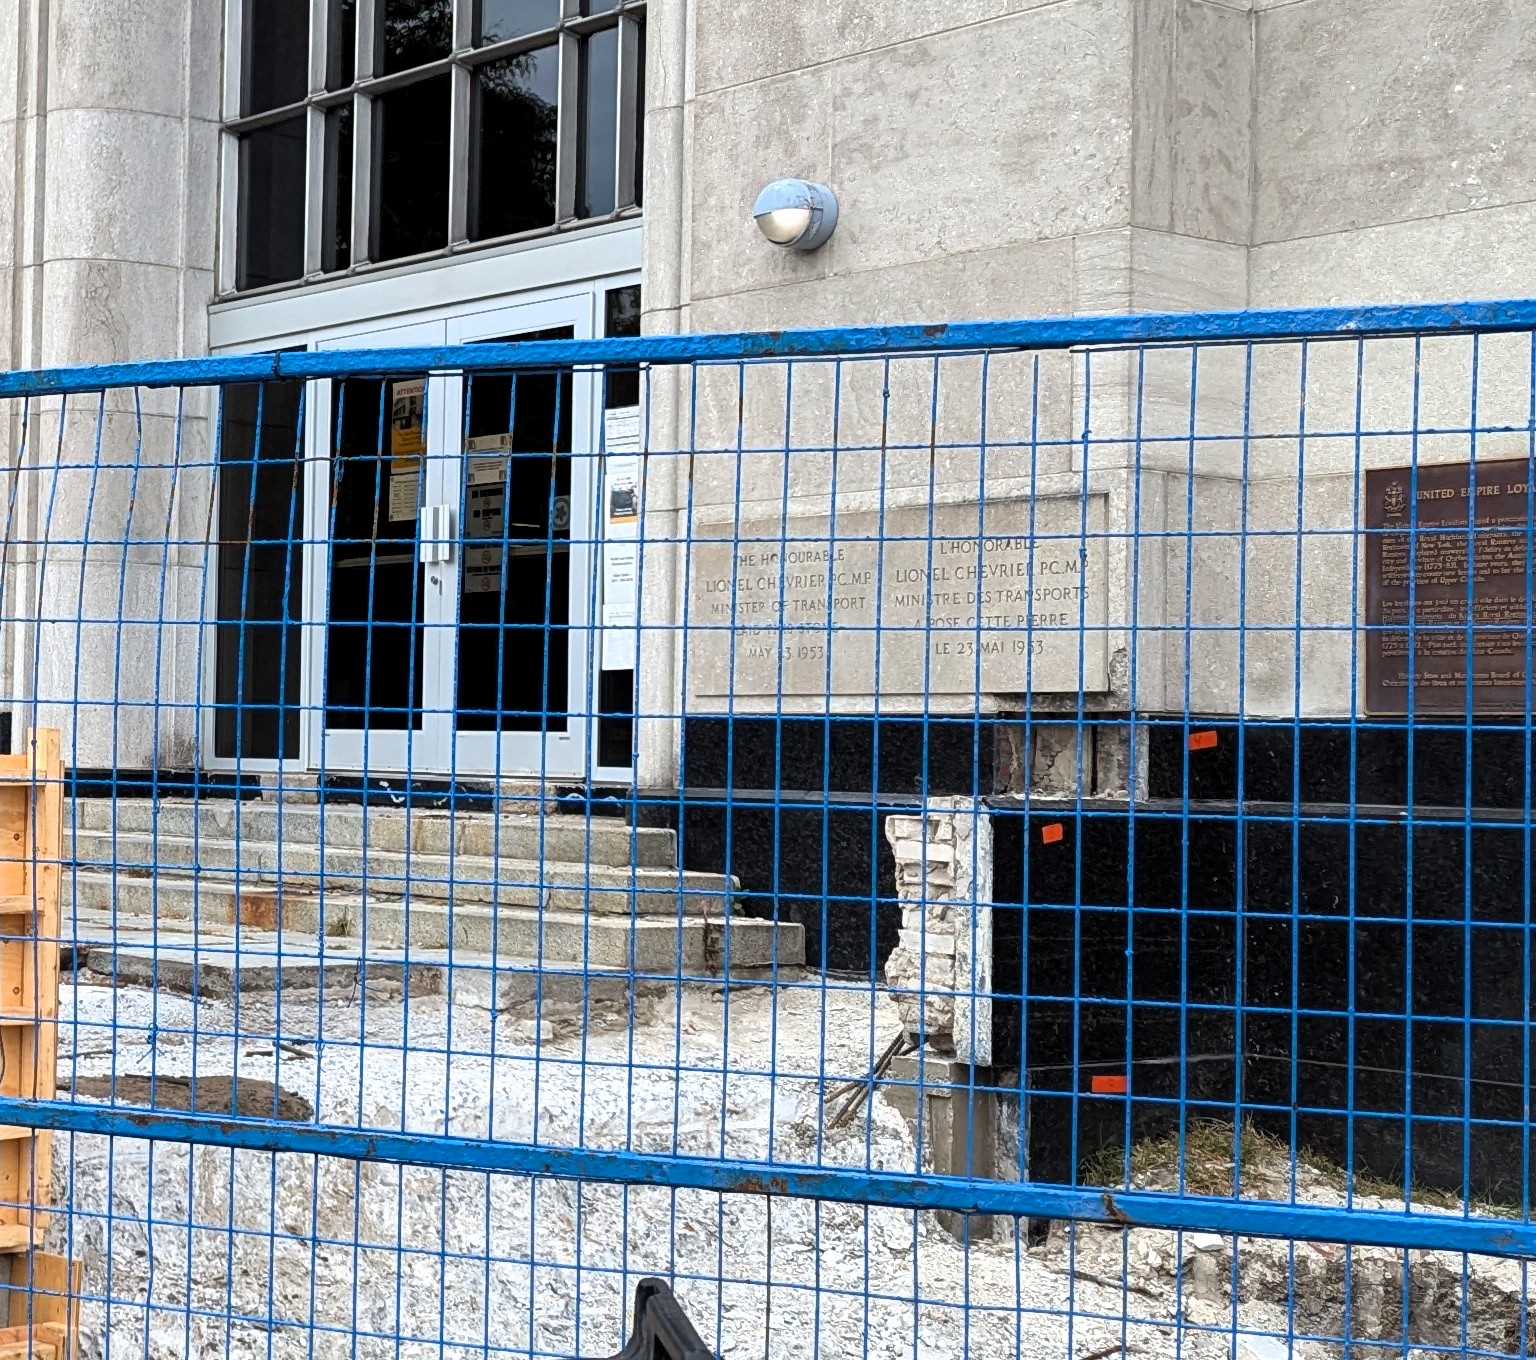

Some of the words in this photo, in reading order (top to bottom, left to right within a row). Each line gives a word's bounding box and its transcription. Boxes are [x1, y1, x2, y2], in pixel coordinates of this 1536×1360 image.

[1417, 488, 1454, 500] UNITED
[734, 554, 755, 567] HE
[896, 567, 949, 583] LIONEL
[706, 578, 753, 593] LIONEL
[757, 574, 826, 591] CHVRIER
[711, 601, 765, 615] MINSTER
[771, 600, 789, 613] OF
[793, 597, 866, 612] TRANPORT
[894, 593, 961, 608] MINITRE
[1017, 613, 1069, 627] PERRE
[748, 645, 772, 659] MAY
[797, 646, 824, 660] 1953
[935, 643, 950, 655] LE
[981, 641, 1004, 654] MAI
[1012, 640, 1044, 656] 1953
